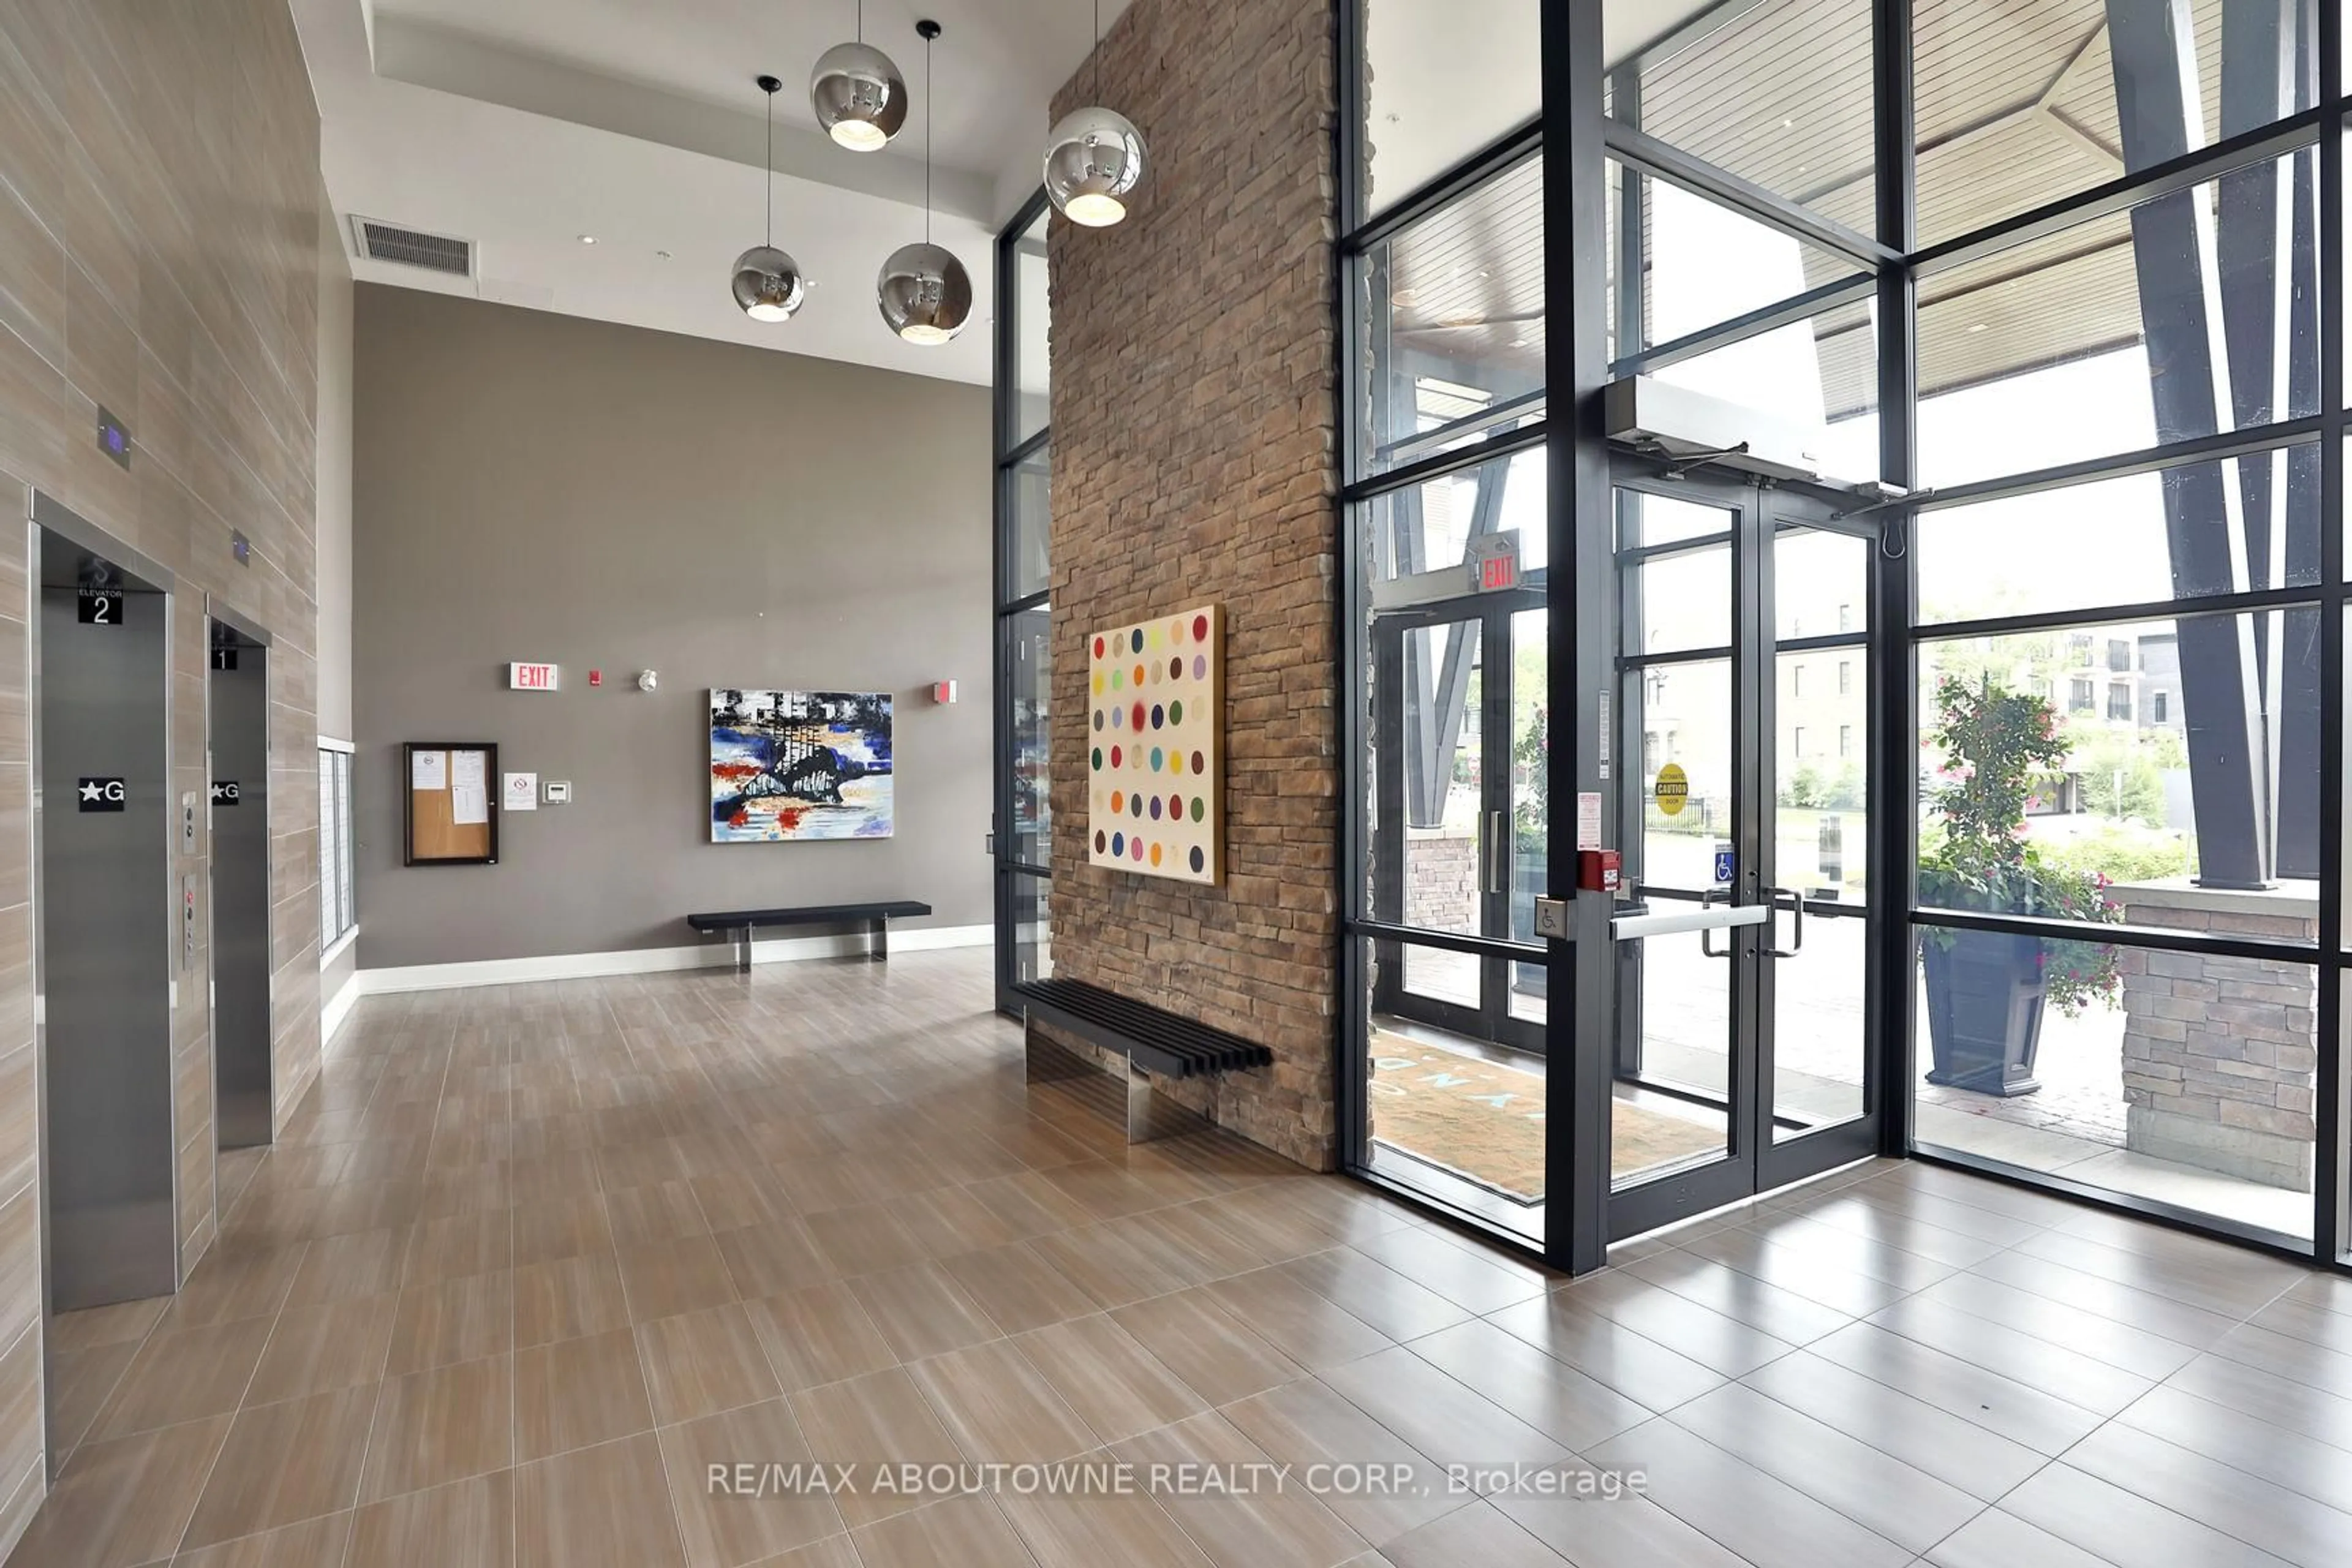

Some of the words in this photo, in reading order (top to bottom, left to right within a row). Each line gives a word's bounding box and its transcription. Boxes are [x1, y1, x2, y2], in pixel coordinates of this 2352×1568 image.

[1483, 554, 1513, 589] EXIT
[78, 589, 123, 598] ELEVATOR
[94, 597, 109, 624] 2
[219, 650, 226, 670] 1
[519, 665, 550, 688] EXIT
[105, 781, 125, 801] G
[1657, 783, 1687, 795] CAUTION
